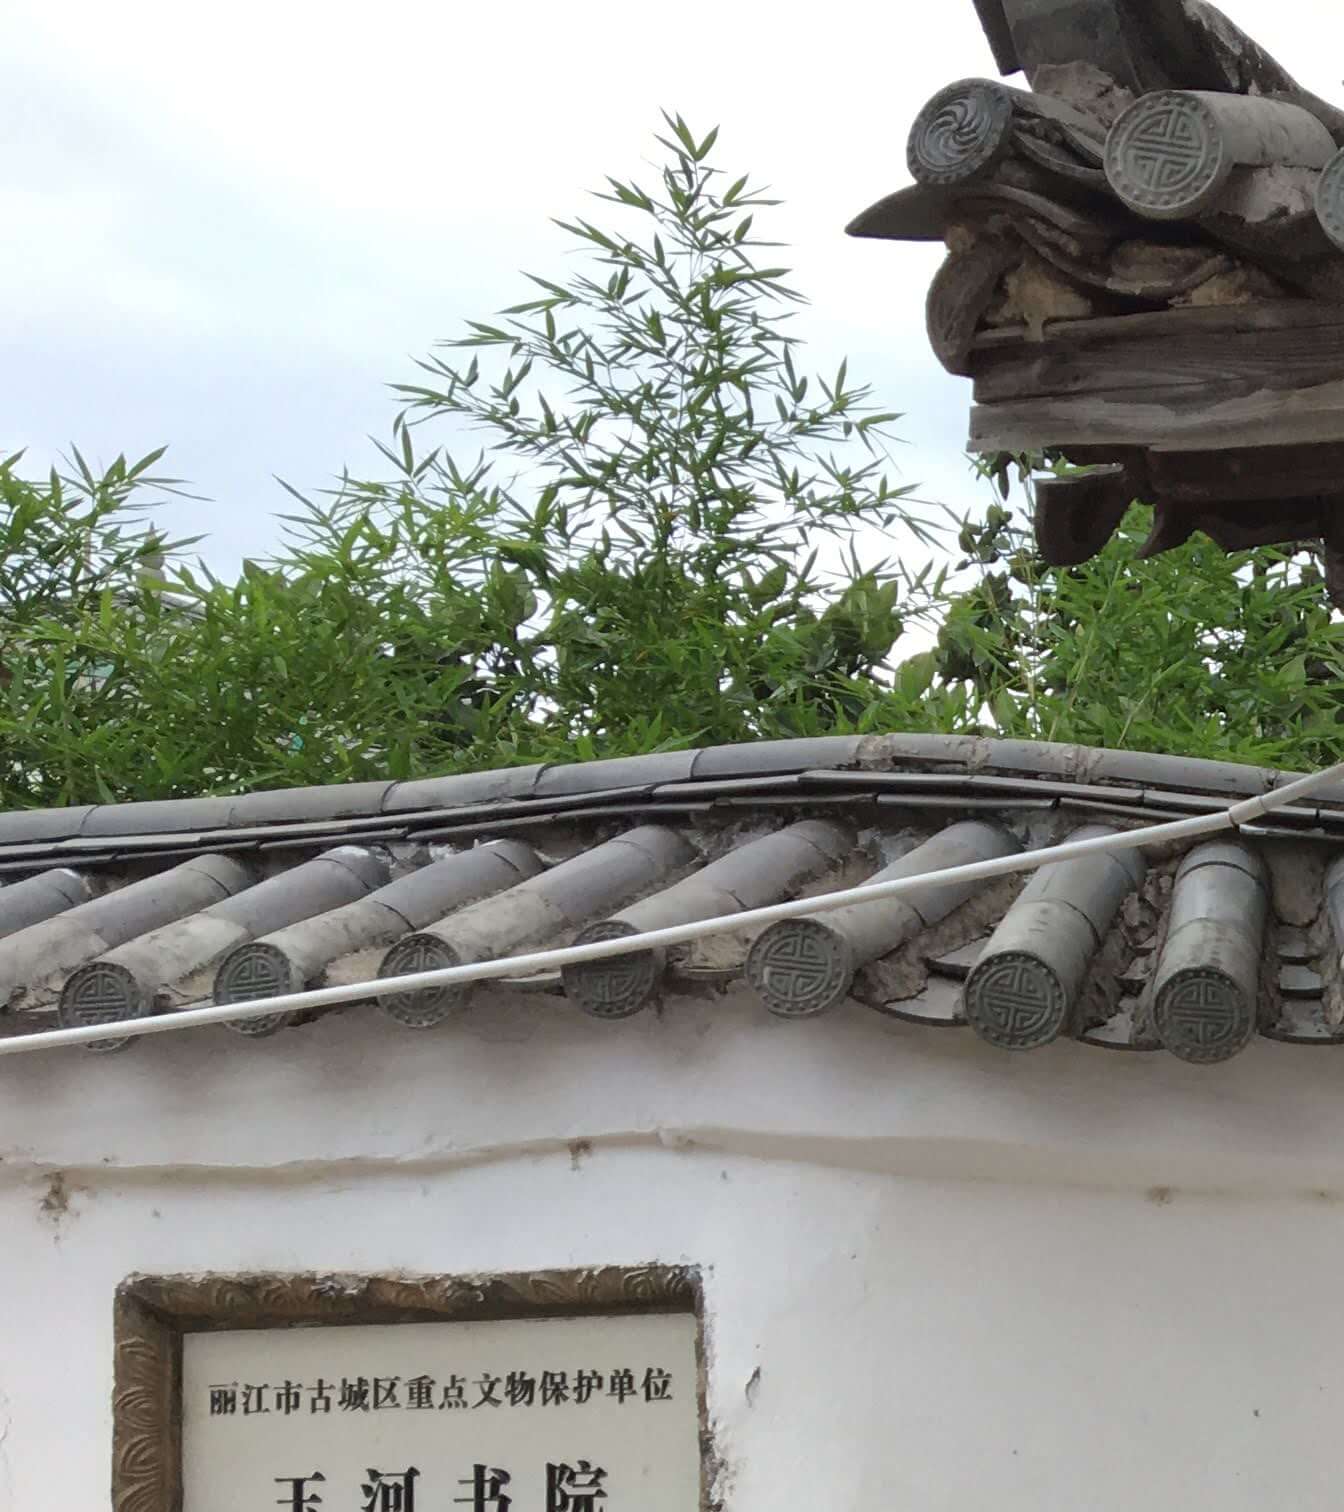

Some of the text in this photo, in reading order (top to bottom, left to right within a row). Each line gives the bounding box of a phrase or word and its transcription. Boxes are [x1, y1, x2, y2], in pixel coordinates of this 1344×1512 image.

[208, 1367, 673, 1416] 丽江市古城区重点文物保护单位
